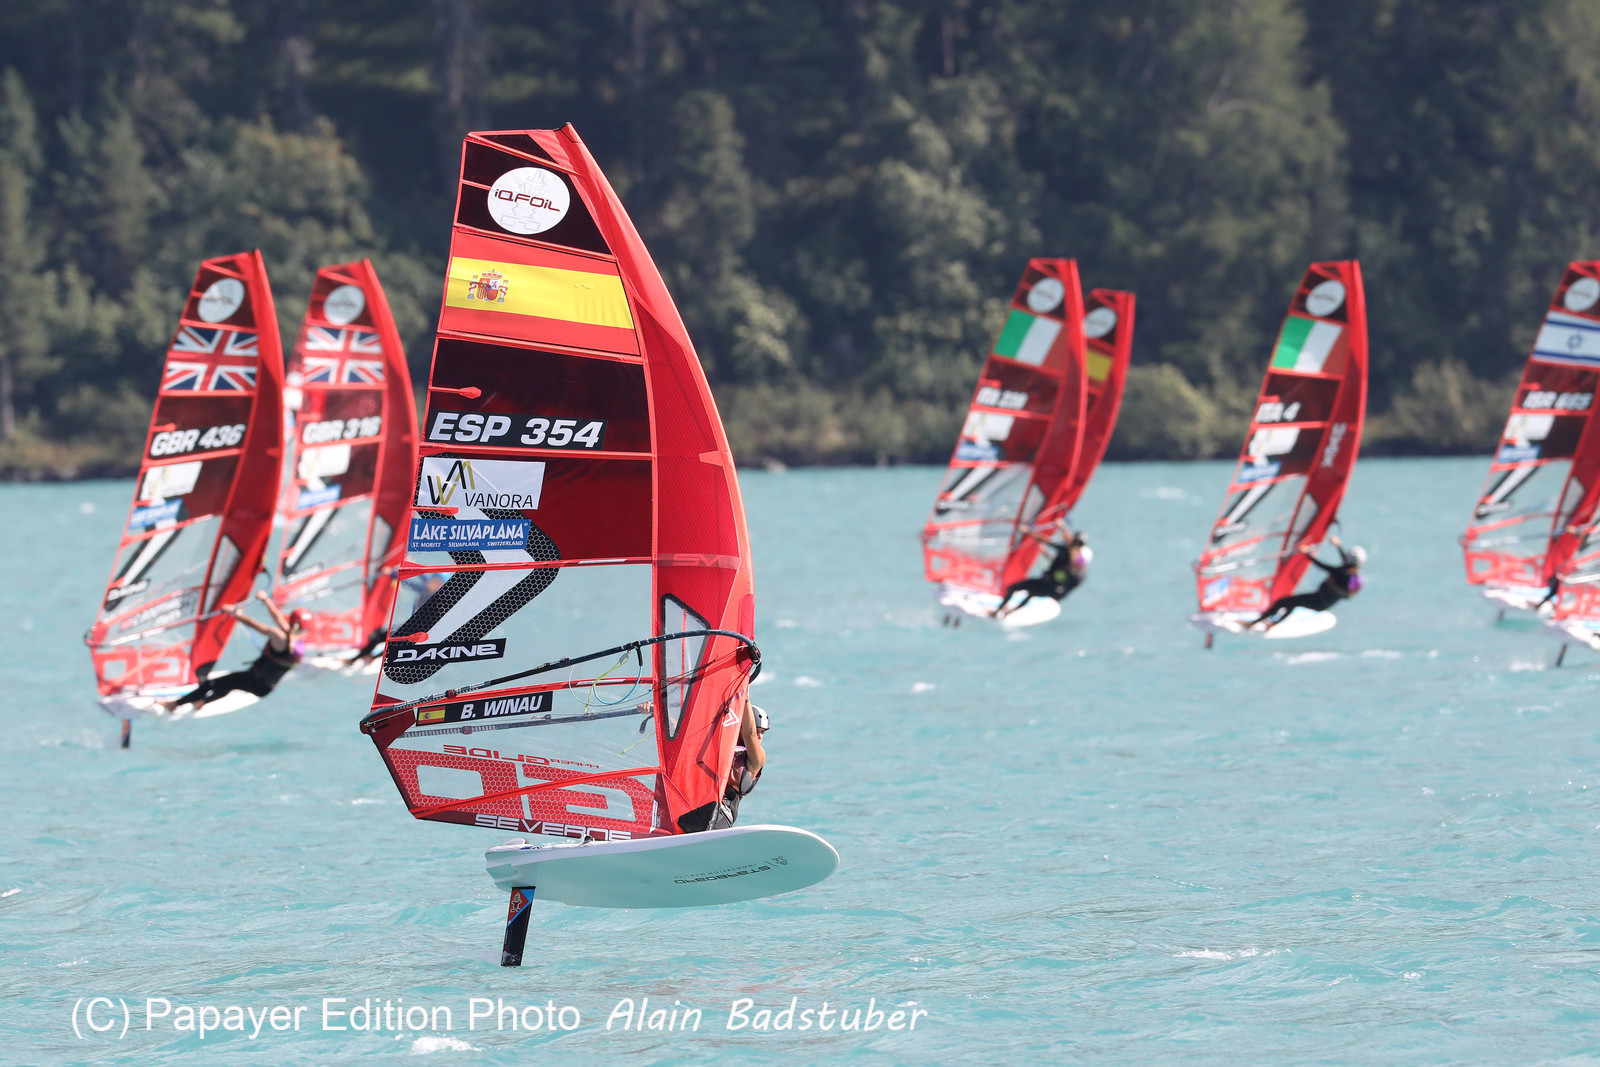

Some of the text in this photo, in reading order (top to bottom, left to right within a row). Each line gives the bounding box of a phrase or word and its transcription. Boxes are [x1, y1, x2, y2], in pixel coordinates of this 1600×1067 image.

[150, 423, 247, 456] GBR 436
[428, 411, 604, 448] ESP 354
[464, 492, 534, 509] VANORA
[412, 522, 525, 542] LAKE SILVAPLANA
[392, 643, 500, 663] DAKINE
[460, 695, 544, 720] B. WINAU
[474, 813, 632, 842] SEVERNE
